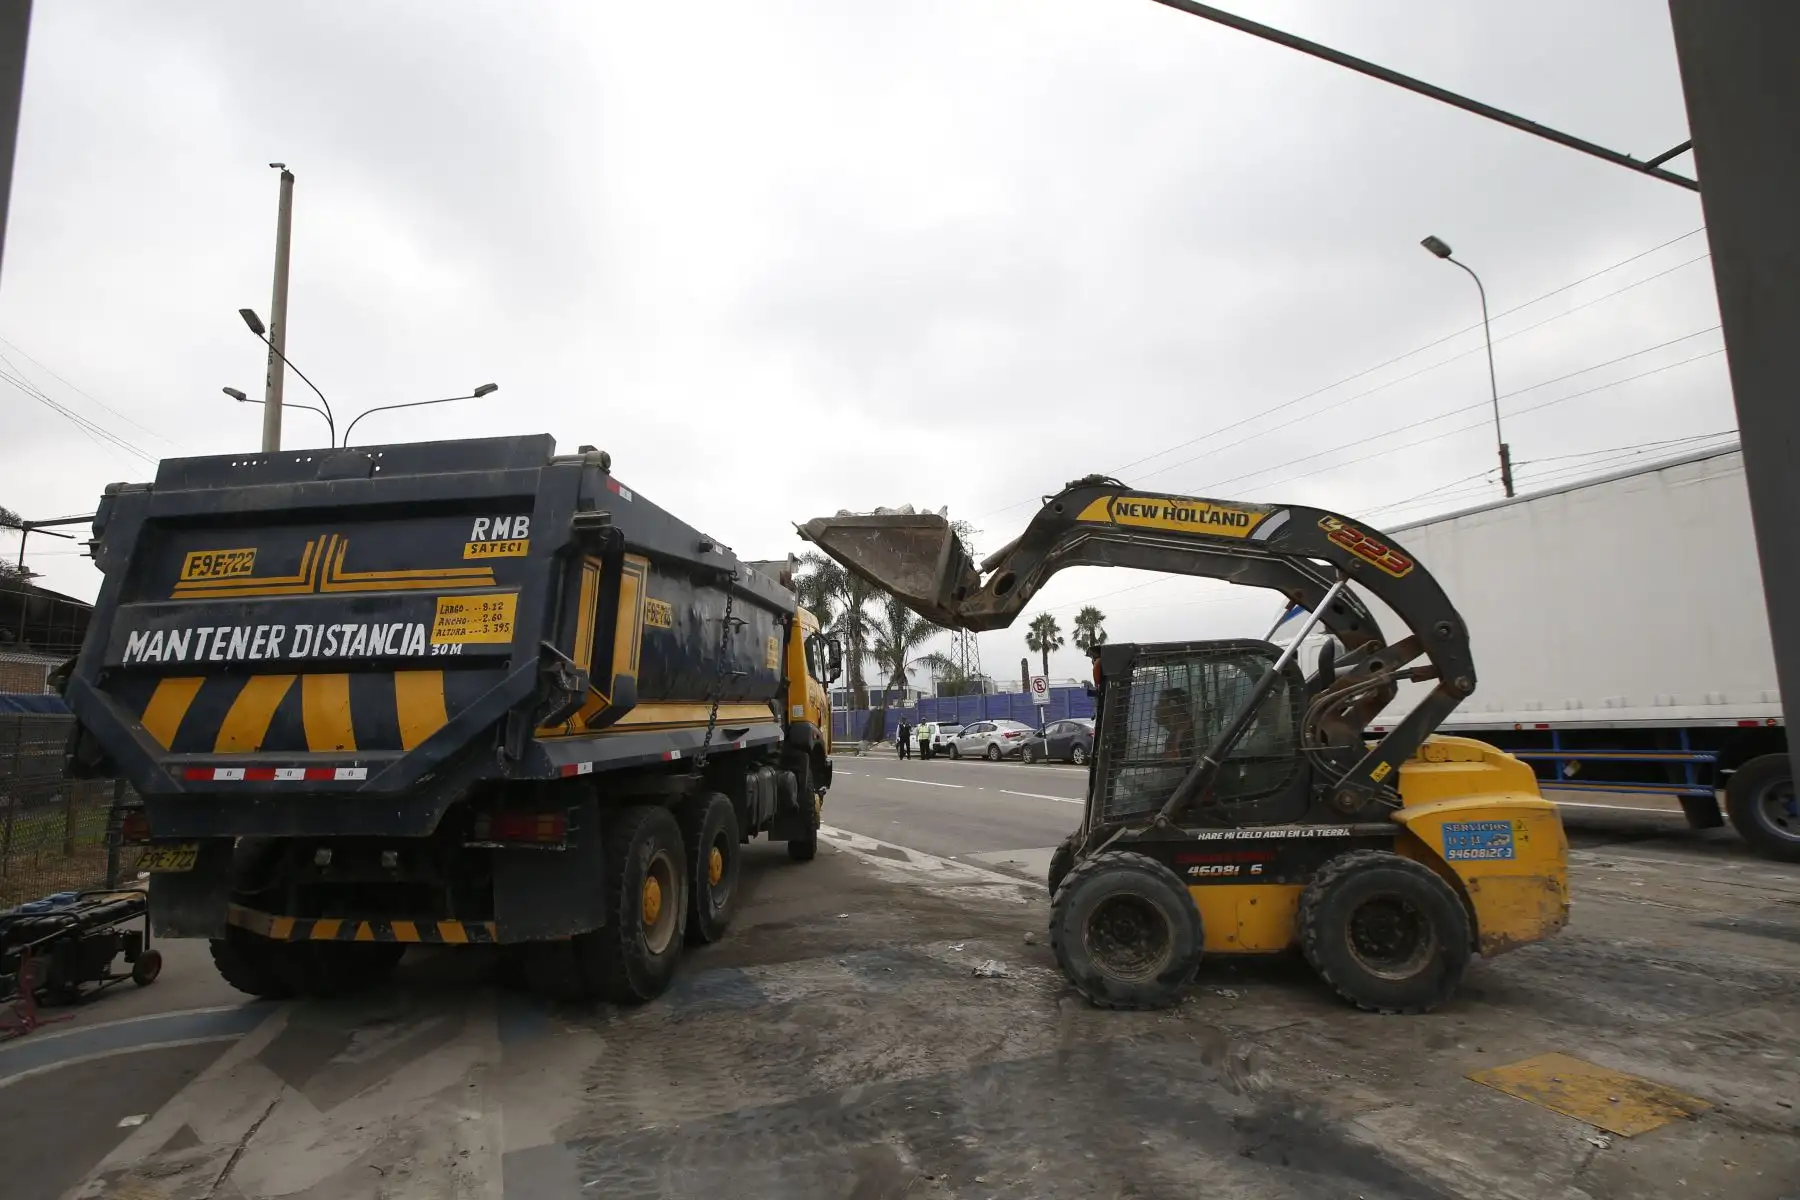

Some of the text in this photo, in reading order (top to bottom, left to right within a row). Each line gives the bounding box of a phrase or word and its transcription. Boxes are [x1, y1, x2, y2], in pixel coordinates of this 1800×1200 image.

[1116, 502, 1249, 527] NEW HOLLAND
[471, 515, 530, 541] RMB
[471, 542, 522, 554] SATECI
[440, 604, 464, 615] LARGO
[439, 618, 467, 626] ANCHO
[436, 628, 466, 637] ALTURA
[123, 623, 425, 662] MANTENER DISTANCIA
[1224, 832, 1235, 840] MI
[1236, 830, 1261, 839] CIELO
[1287, 829, 1299, 838] EN
[1316, 828, 1350, 837] TIERRA
